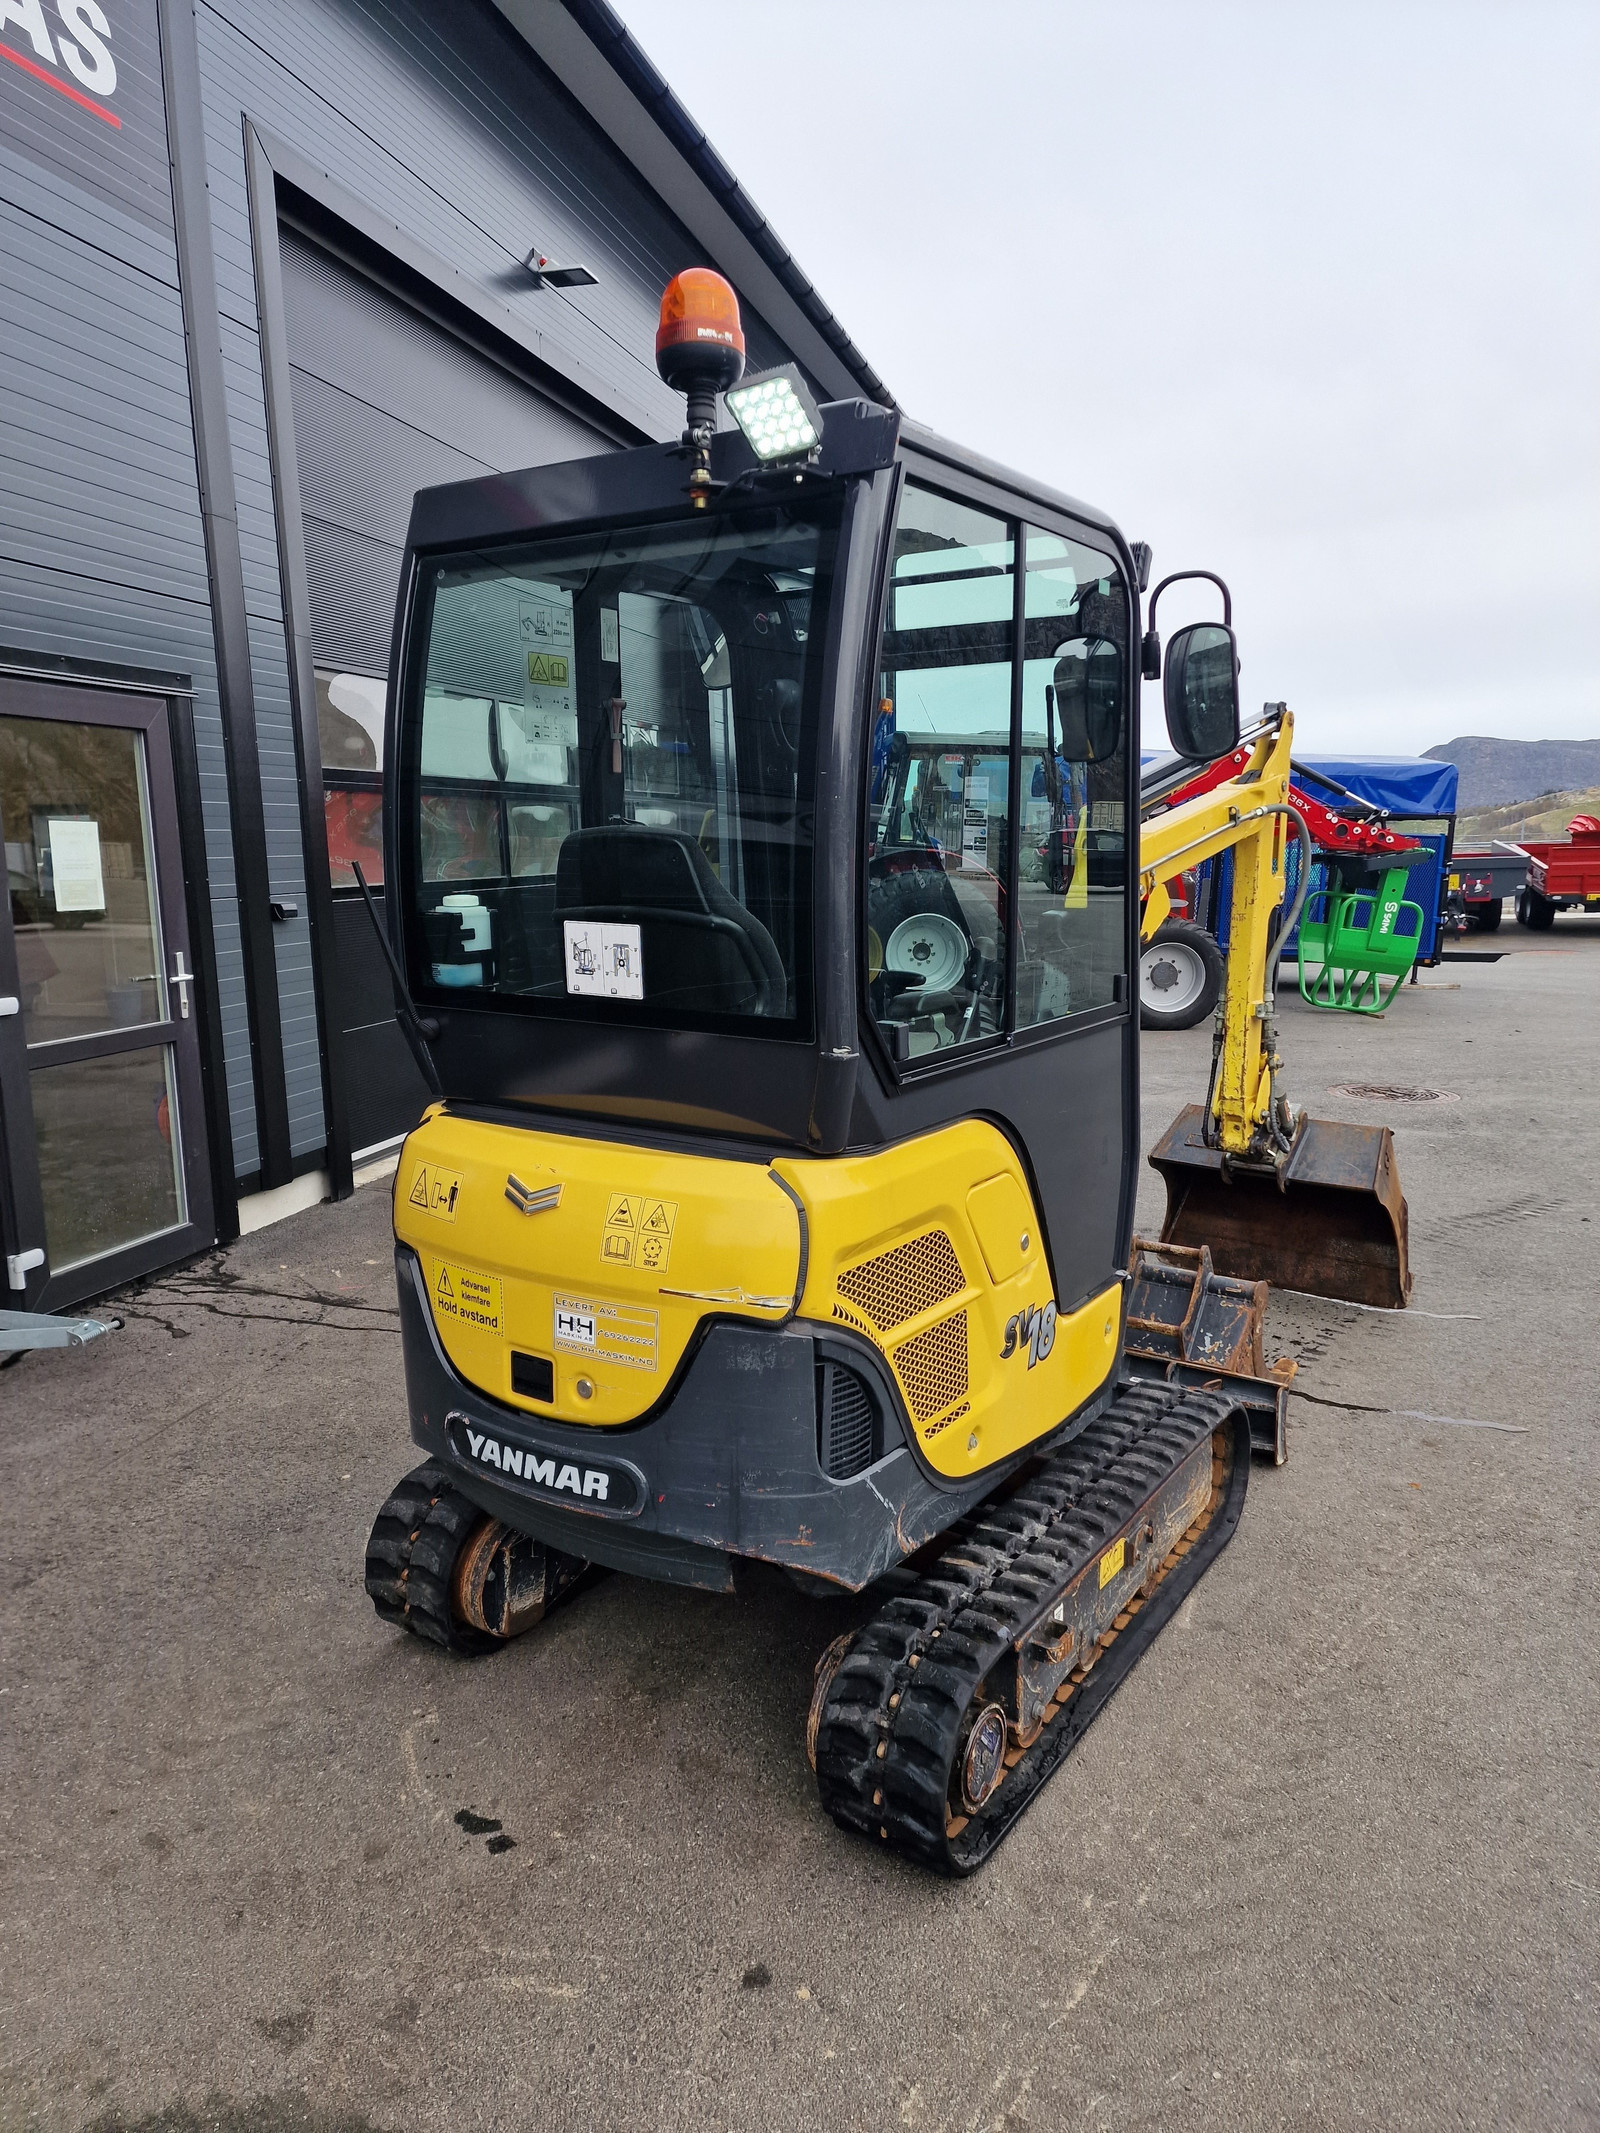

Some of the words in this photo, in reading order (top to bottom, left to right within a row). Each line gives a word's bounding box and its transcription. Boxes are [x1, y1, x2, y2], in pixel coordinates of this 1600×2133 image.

[643, 1259, 659, 1268] STOP
[460, 1277, 491, 1294] Advarsel
[461, 1290, 491, 1307] klemfare
[555, 1297, 595, 1312] LEVERT
[599, 1306, 617, 1317] AV:
[437, 1296, 457, 1315] Hold
[459, 1307, 498, 1329] avstand
[558, 1330, 582, 1340] MASKIN
[465, 1428, 610, 1500] YANMAR
